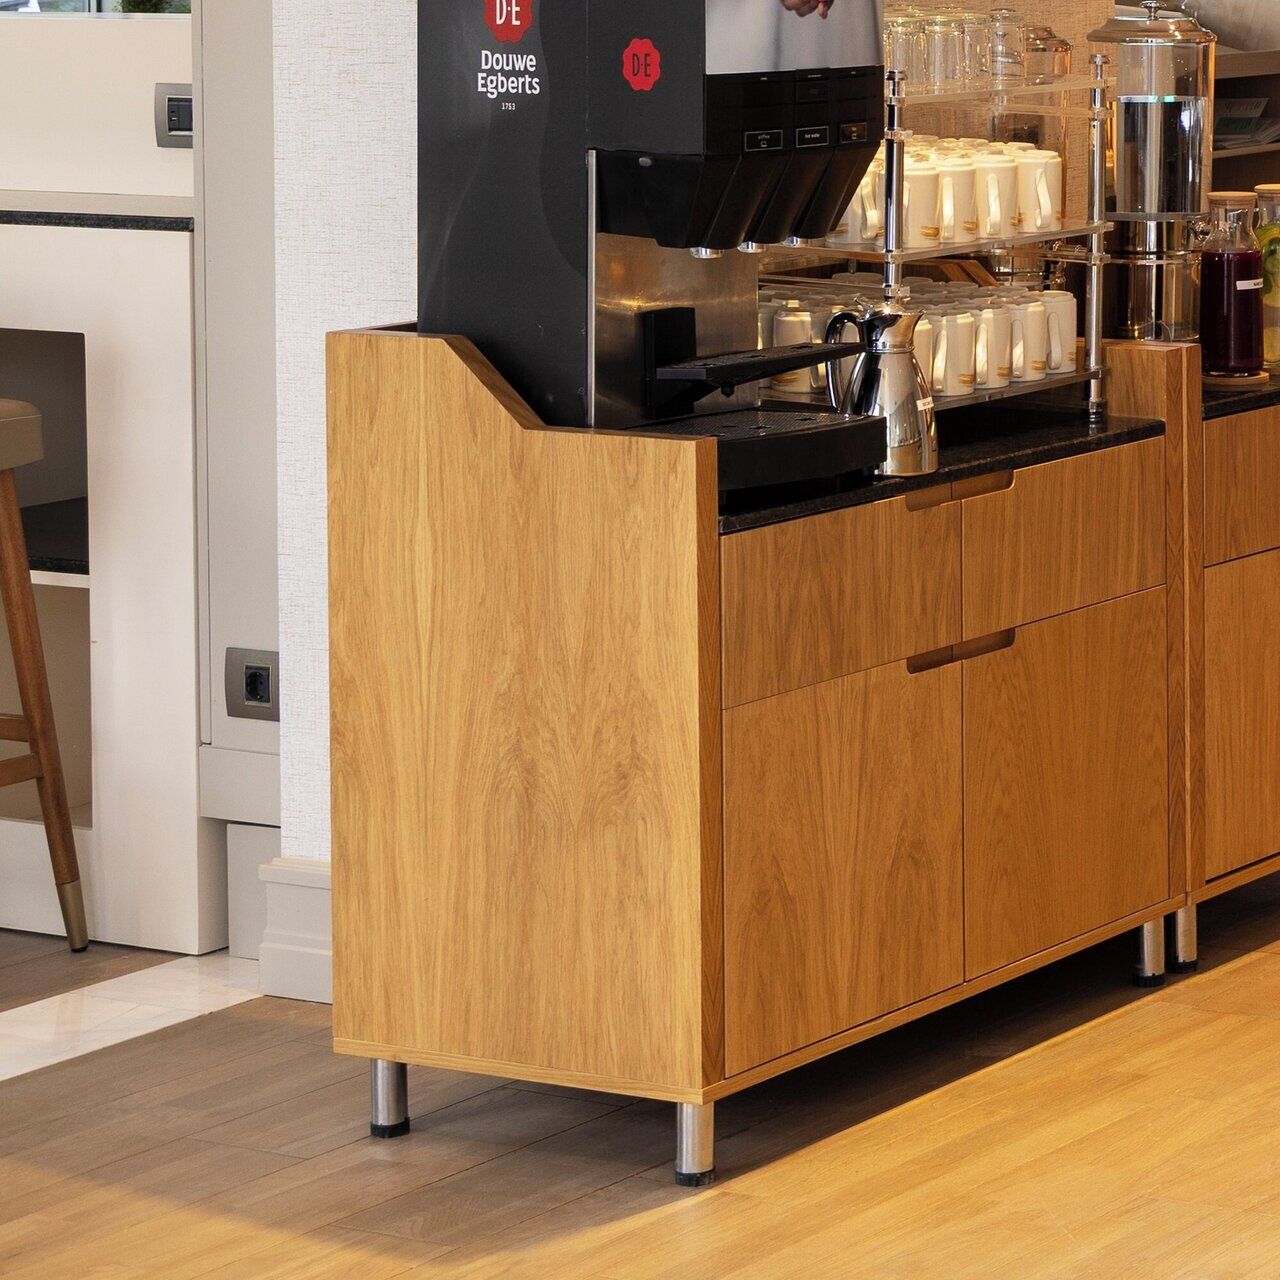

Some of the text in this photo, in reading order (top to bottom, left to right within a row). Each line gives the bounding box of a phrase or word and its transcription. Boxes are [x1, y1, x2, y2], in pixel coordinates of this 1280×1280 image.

[481, 50, 537, 71] Douwe
[477, 73, 541, 99] Egberts
[501, 102, 516, 111] 1753
